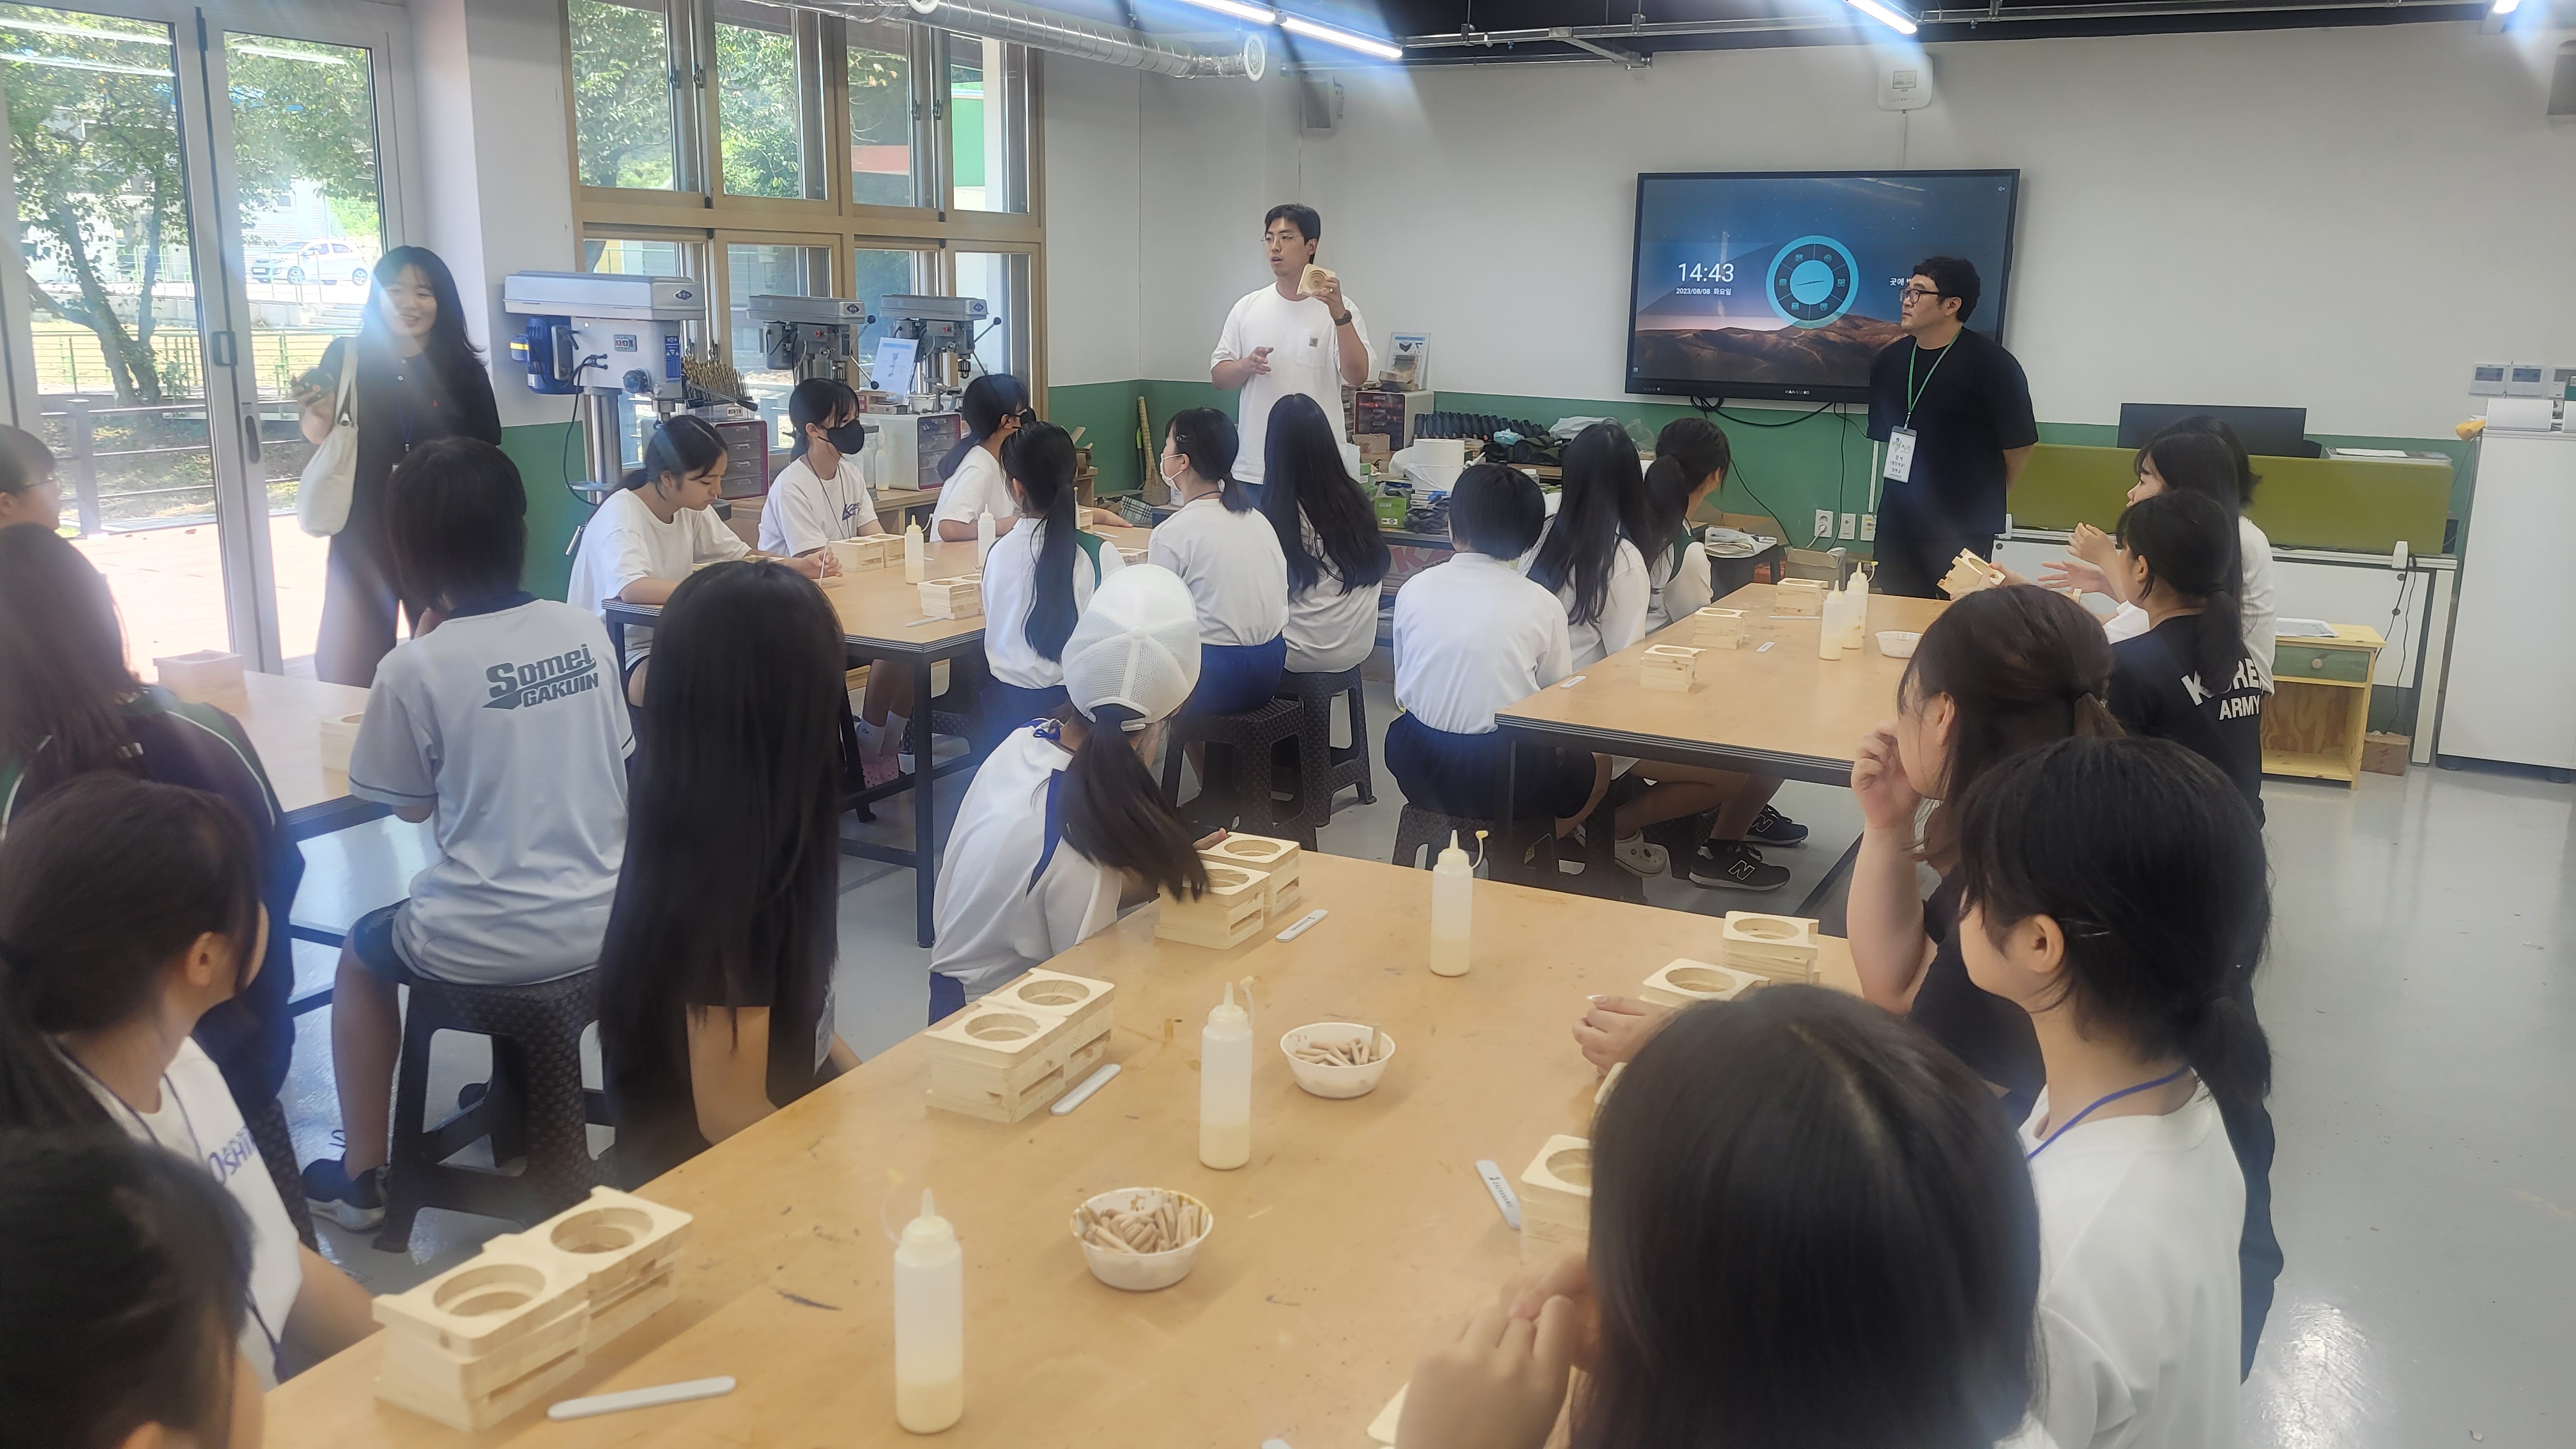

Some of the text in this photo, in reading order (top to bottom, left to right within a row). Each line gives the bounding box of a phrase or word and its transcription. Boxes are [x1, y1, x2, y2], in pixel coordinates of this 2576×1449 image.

[1678, 263, 1735, 282] 14:43
[1713, 288, 1731, 296] 화요일
[486, 644, 597, 698] Somei
[2181, 657, 2264, 705] KRE
[521, 672, 599, 707] GAKUIN
[2219, 694, 2260, 721] ARMY
[1728, 860, 1756, 880] N
